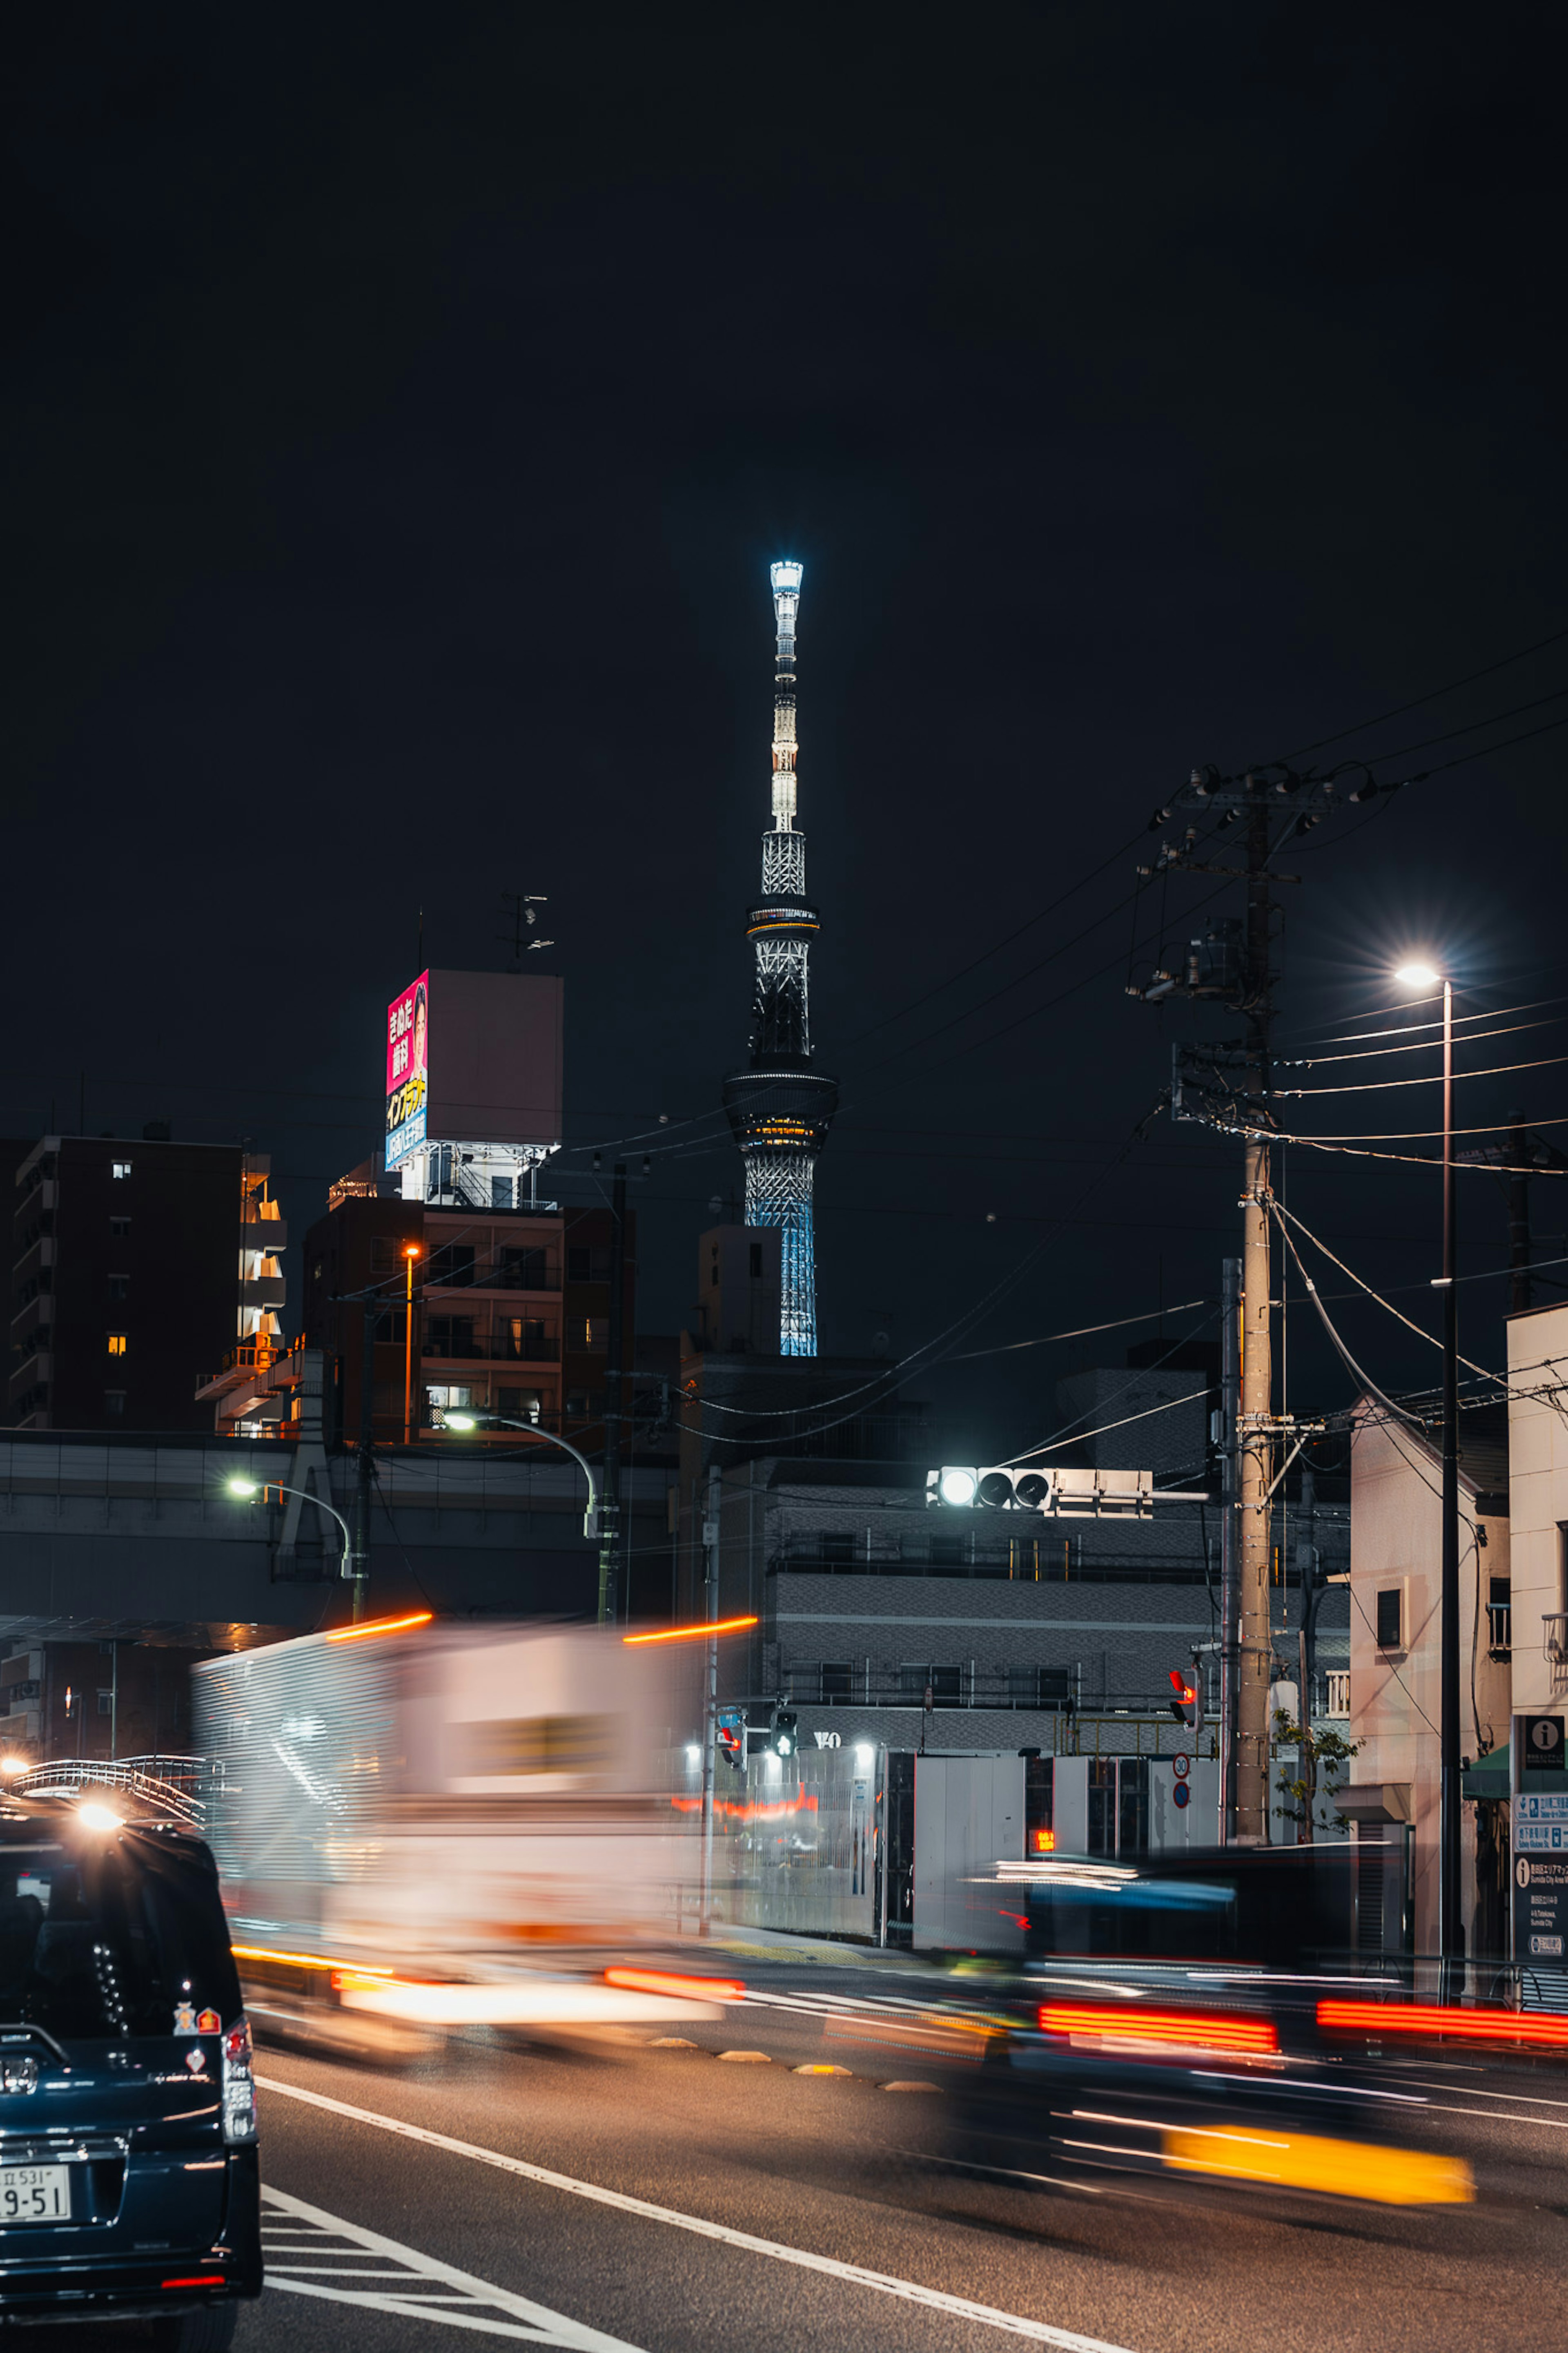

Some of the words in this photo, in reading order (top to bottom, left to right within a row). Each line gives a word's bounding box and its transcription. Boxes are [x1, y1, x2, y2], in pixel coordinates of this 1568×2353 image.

[390, 999, 412, 1044] きぬた
[1176, 1760, 1186, 1772] 30
[20, 2170, 43, 2185] 531
[0, 2188, 59, 2216] 9-51
